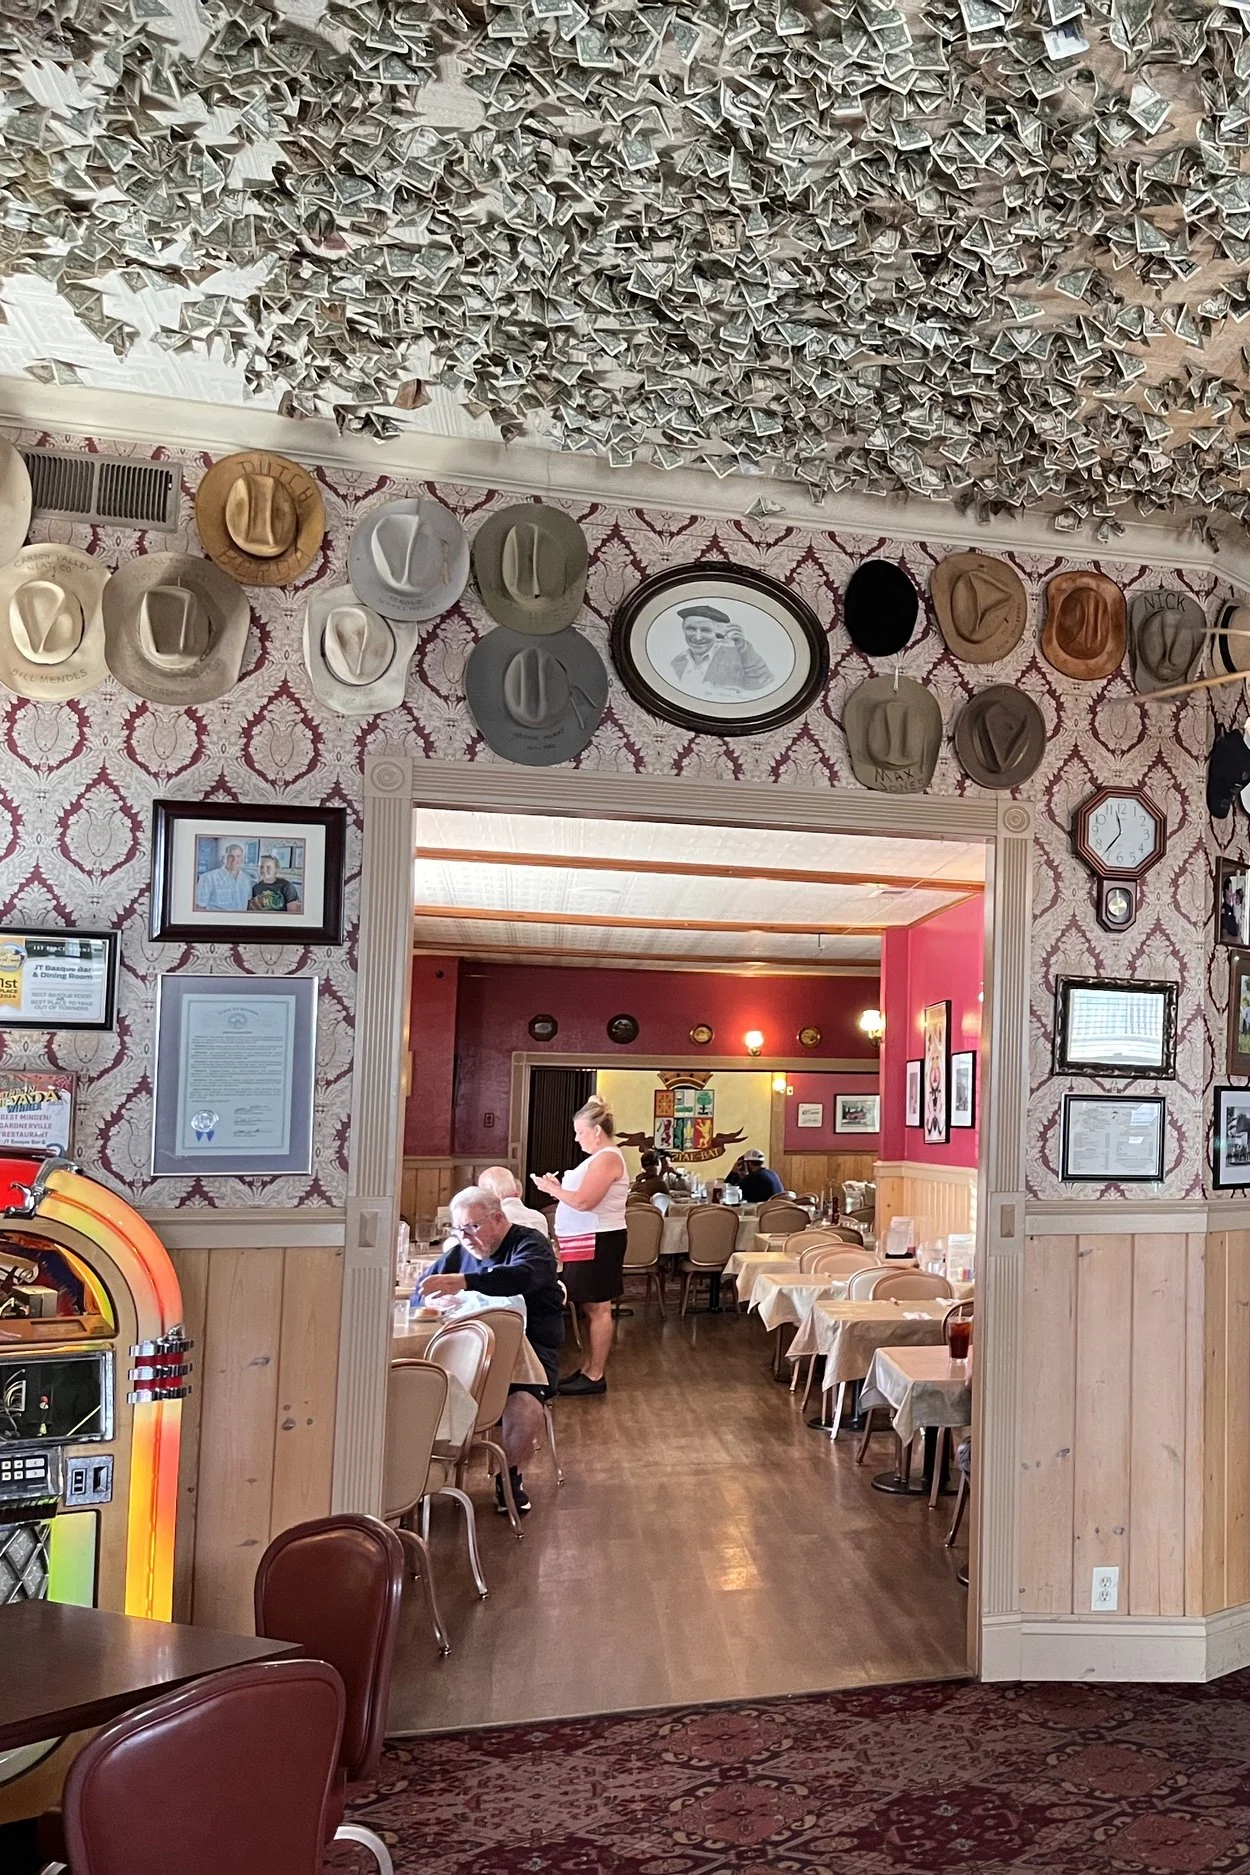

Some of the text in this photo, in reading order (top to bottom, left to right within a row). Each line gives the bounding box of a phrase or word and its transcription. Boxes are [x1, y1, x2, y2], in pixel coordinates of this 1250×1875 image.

[236, 459, 314, 503] DUTCH
[14, 552, 95, 571] CARSON VALLEY
[1144, 593, 1186, 612] NICK
[11, 668, 88, 683] BILL MENDES
[875, 767, 914, 782] MAX
[1117, 803, 1127, 815] 12
[40, 972, 67, 980] Dining
[45, 965, 76, 973] Basque
[77, 965, 92, 973] Bar
[7, 1103, 42, 1113] WINNER
